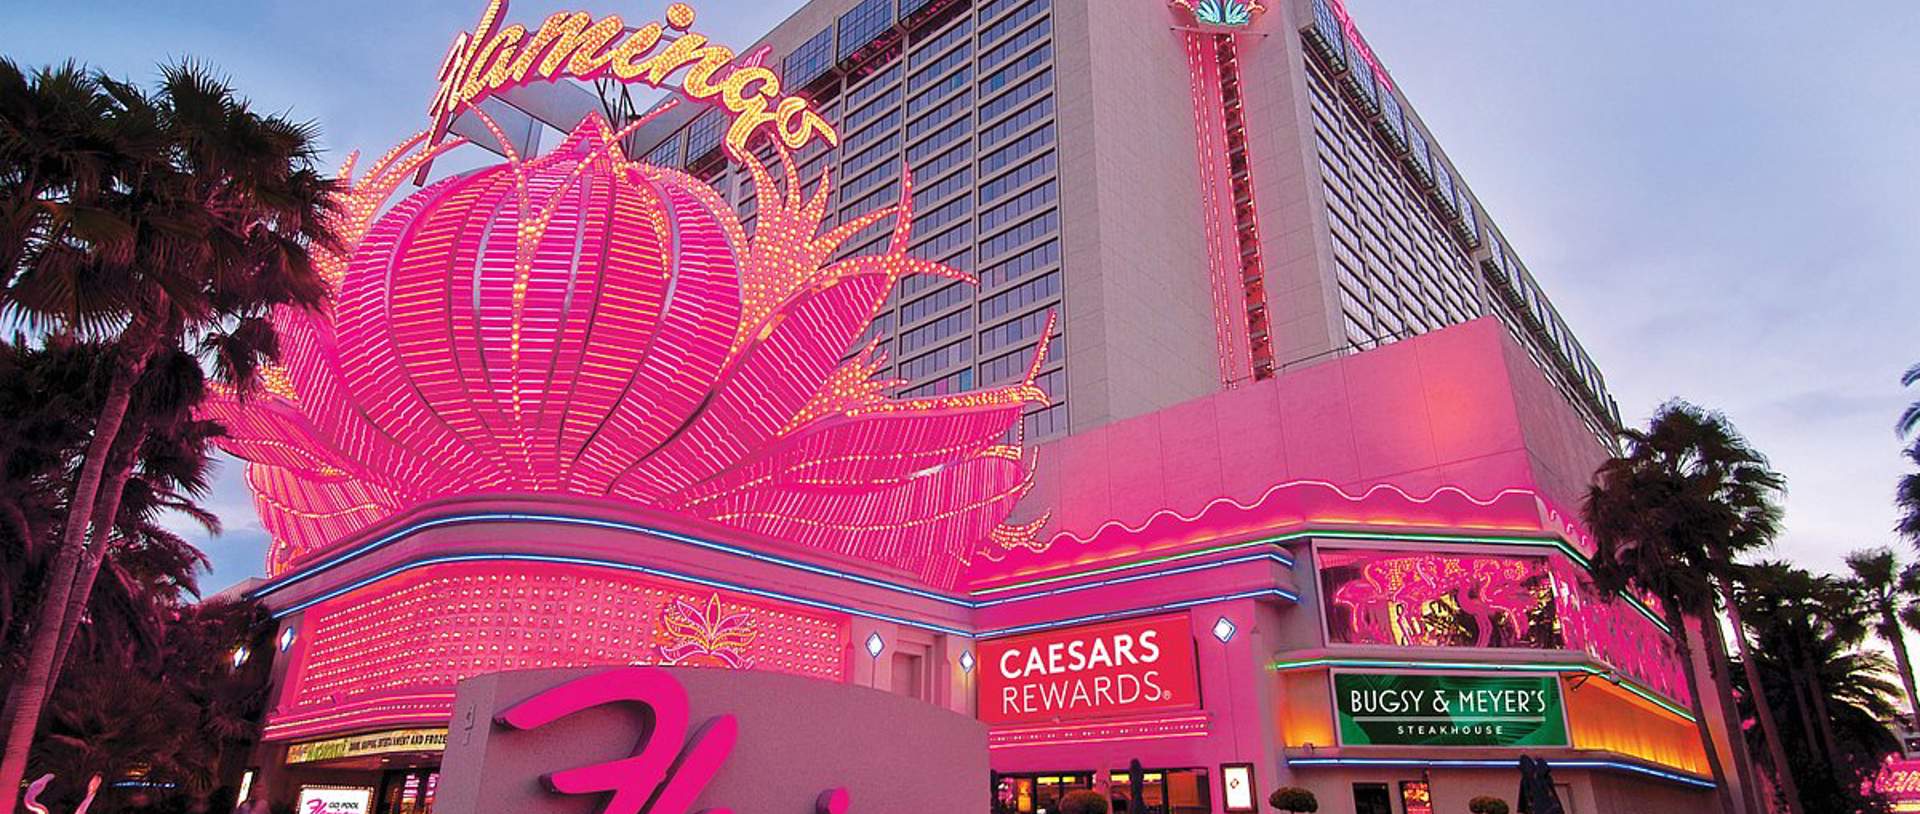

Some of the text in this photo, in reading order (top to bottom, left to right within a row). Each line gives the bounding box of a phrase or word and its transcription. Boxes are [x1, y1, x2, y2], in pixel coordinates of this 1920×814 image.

[1000, 630, 1160, 679] CAESARS
[1350, 689, 1546, 713] BUGSY & MEYER'S
[1397, 725, 1504, 735] STEAKHOUSE
